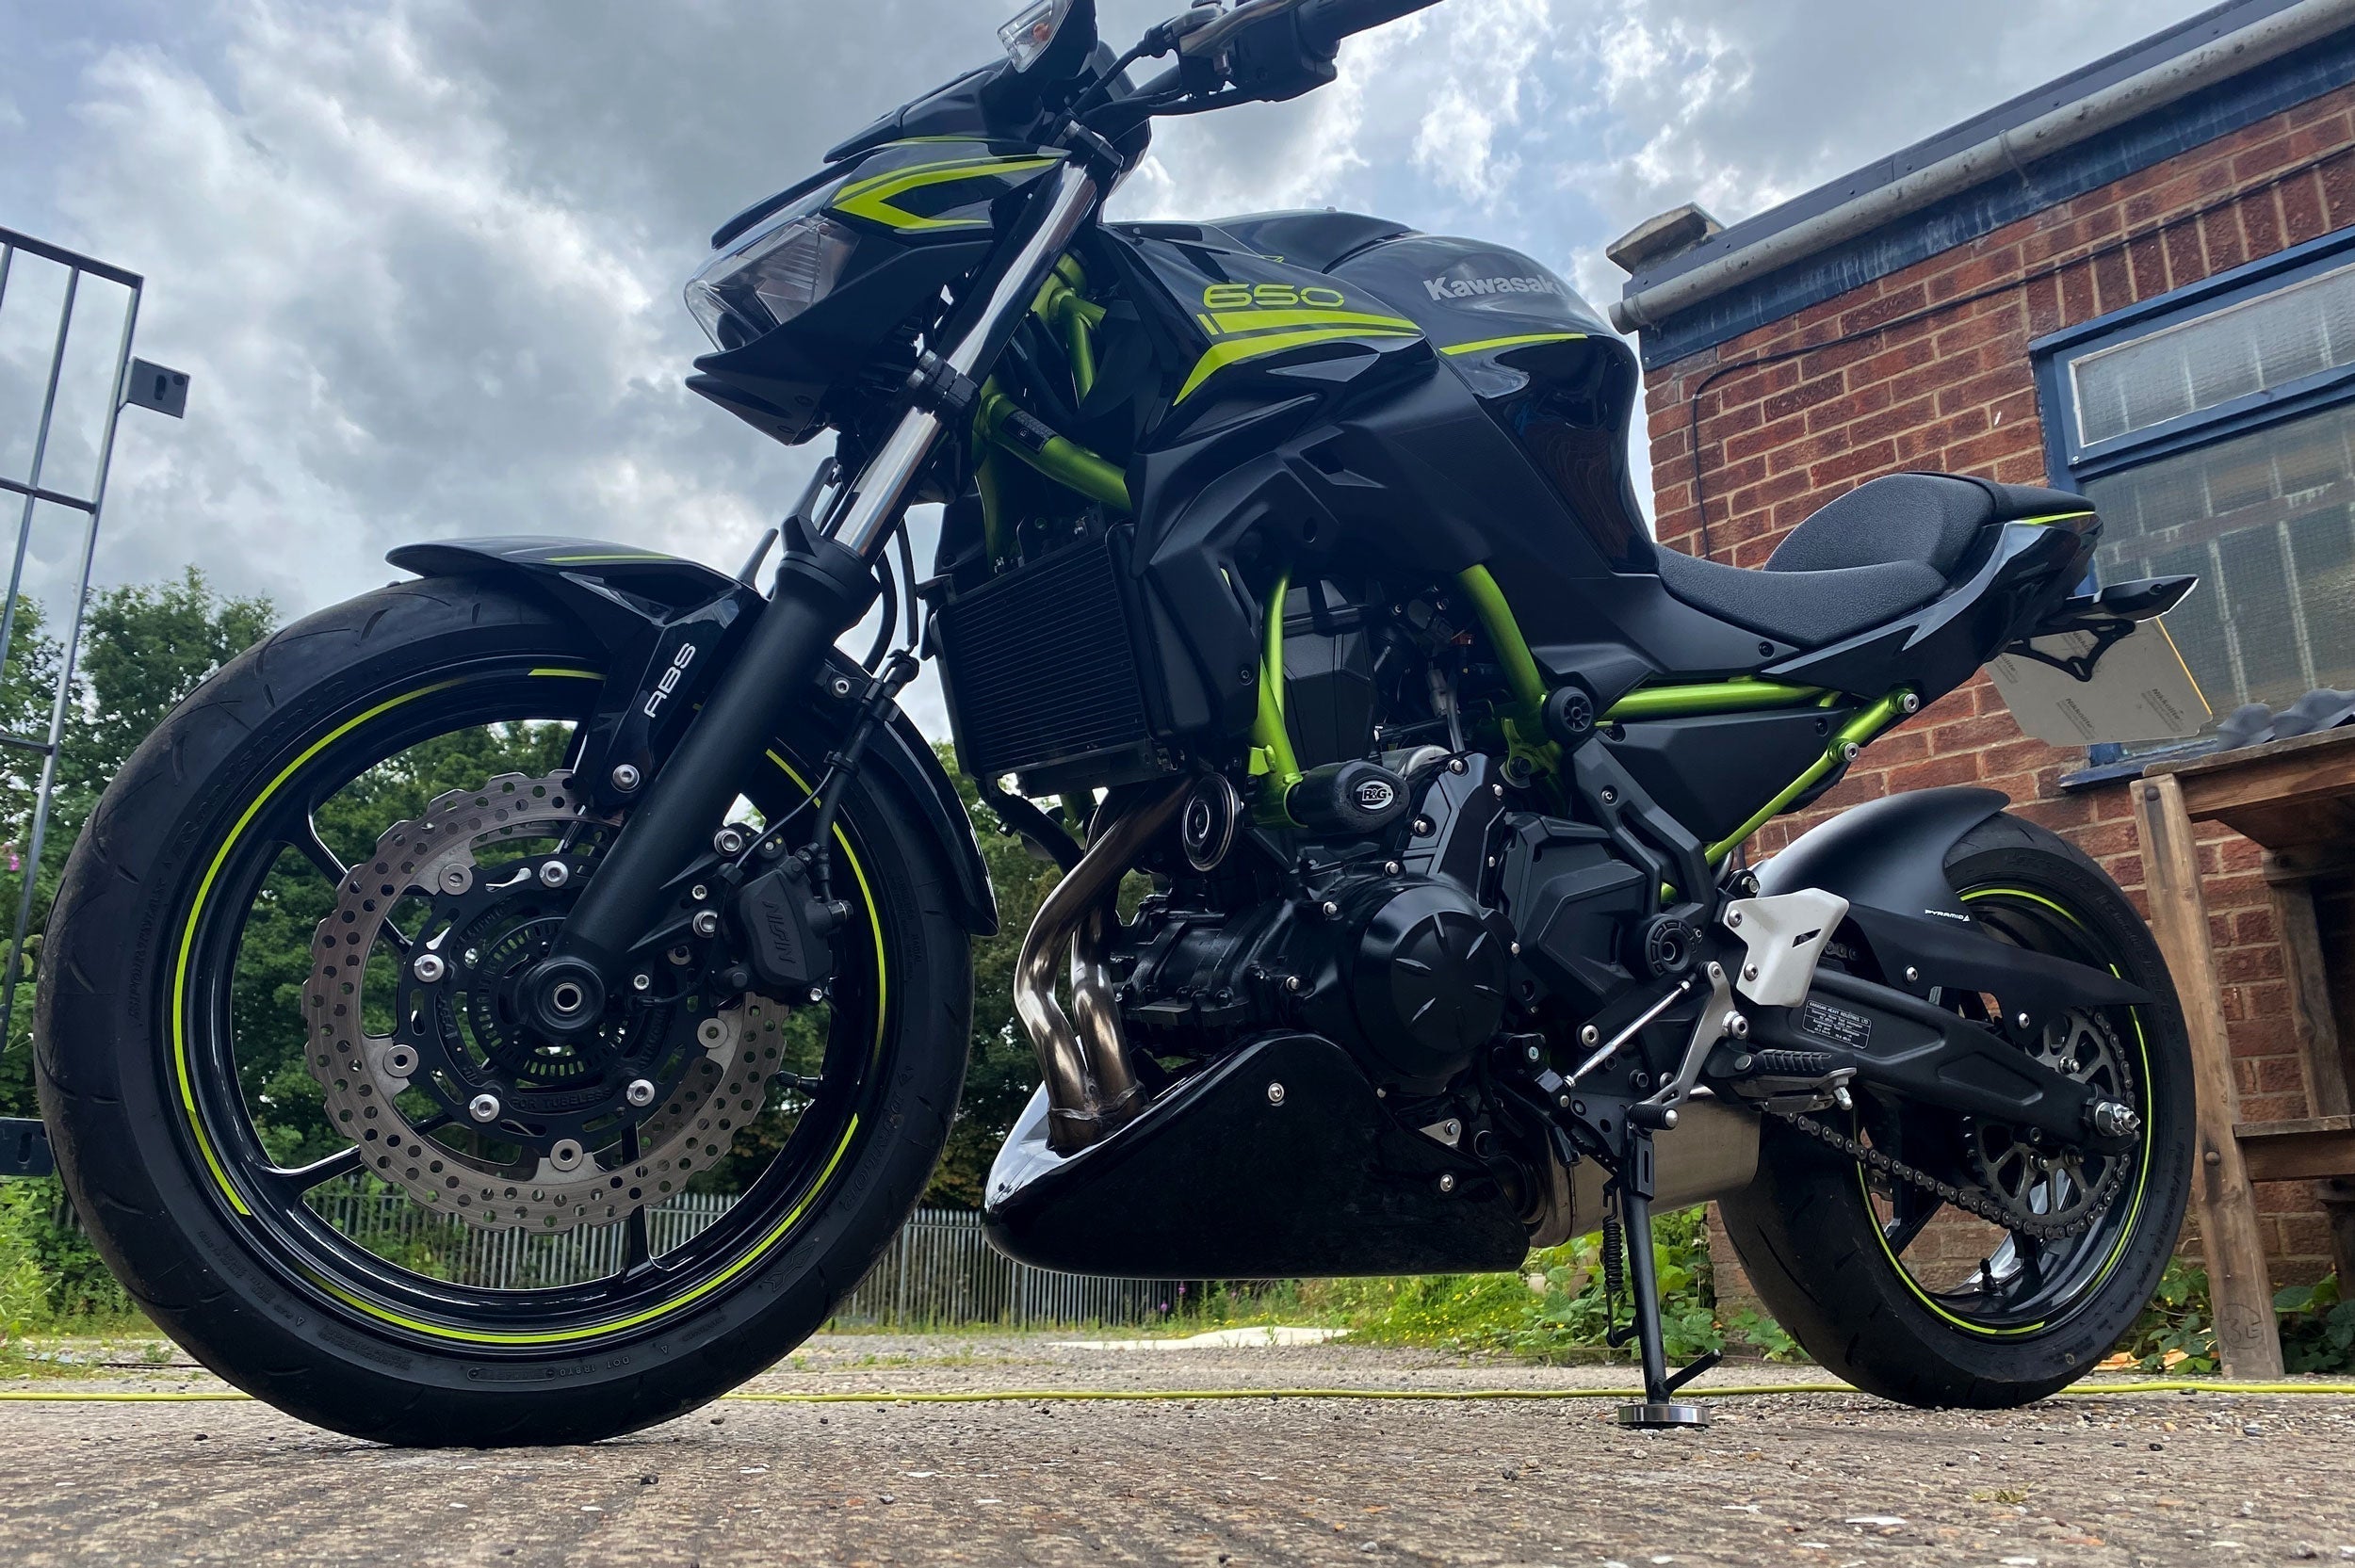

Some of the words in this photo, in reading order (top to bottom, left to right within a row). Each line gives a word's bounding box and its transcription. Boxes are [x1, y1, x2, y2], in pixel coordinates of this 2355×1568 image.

[1202, 283, 1345, 309] 650
[1422, 275, 1564, 301] Kawasaki
[643, 642, 696, 718] ABS
[1362, 788, 1388, 800] R&G
[1925, 909, 1964, 920] PYRAMID
[511, 1098, 538, 1111] FOR
[541, 1090, 610, 1109] TUBELESS
[605, 1356, 630, 1370] DOT
